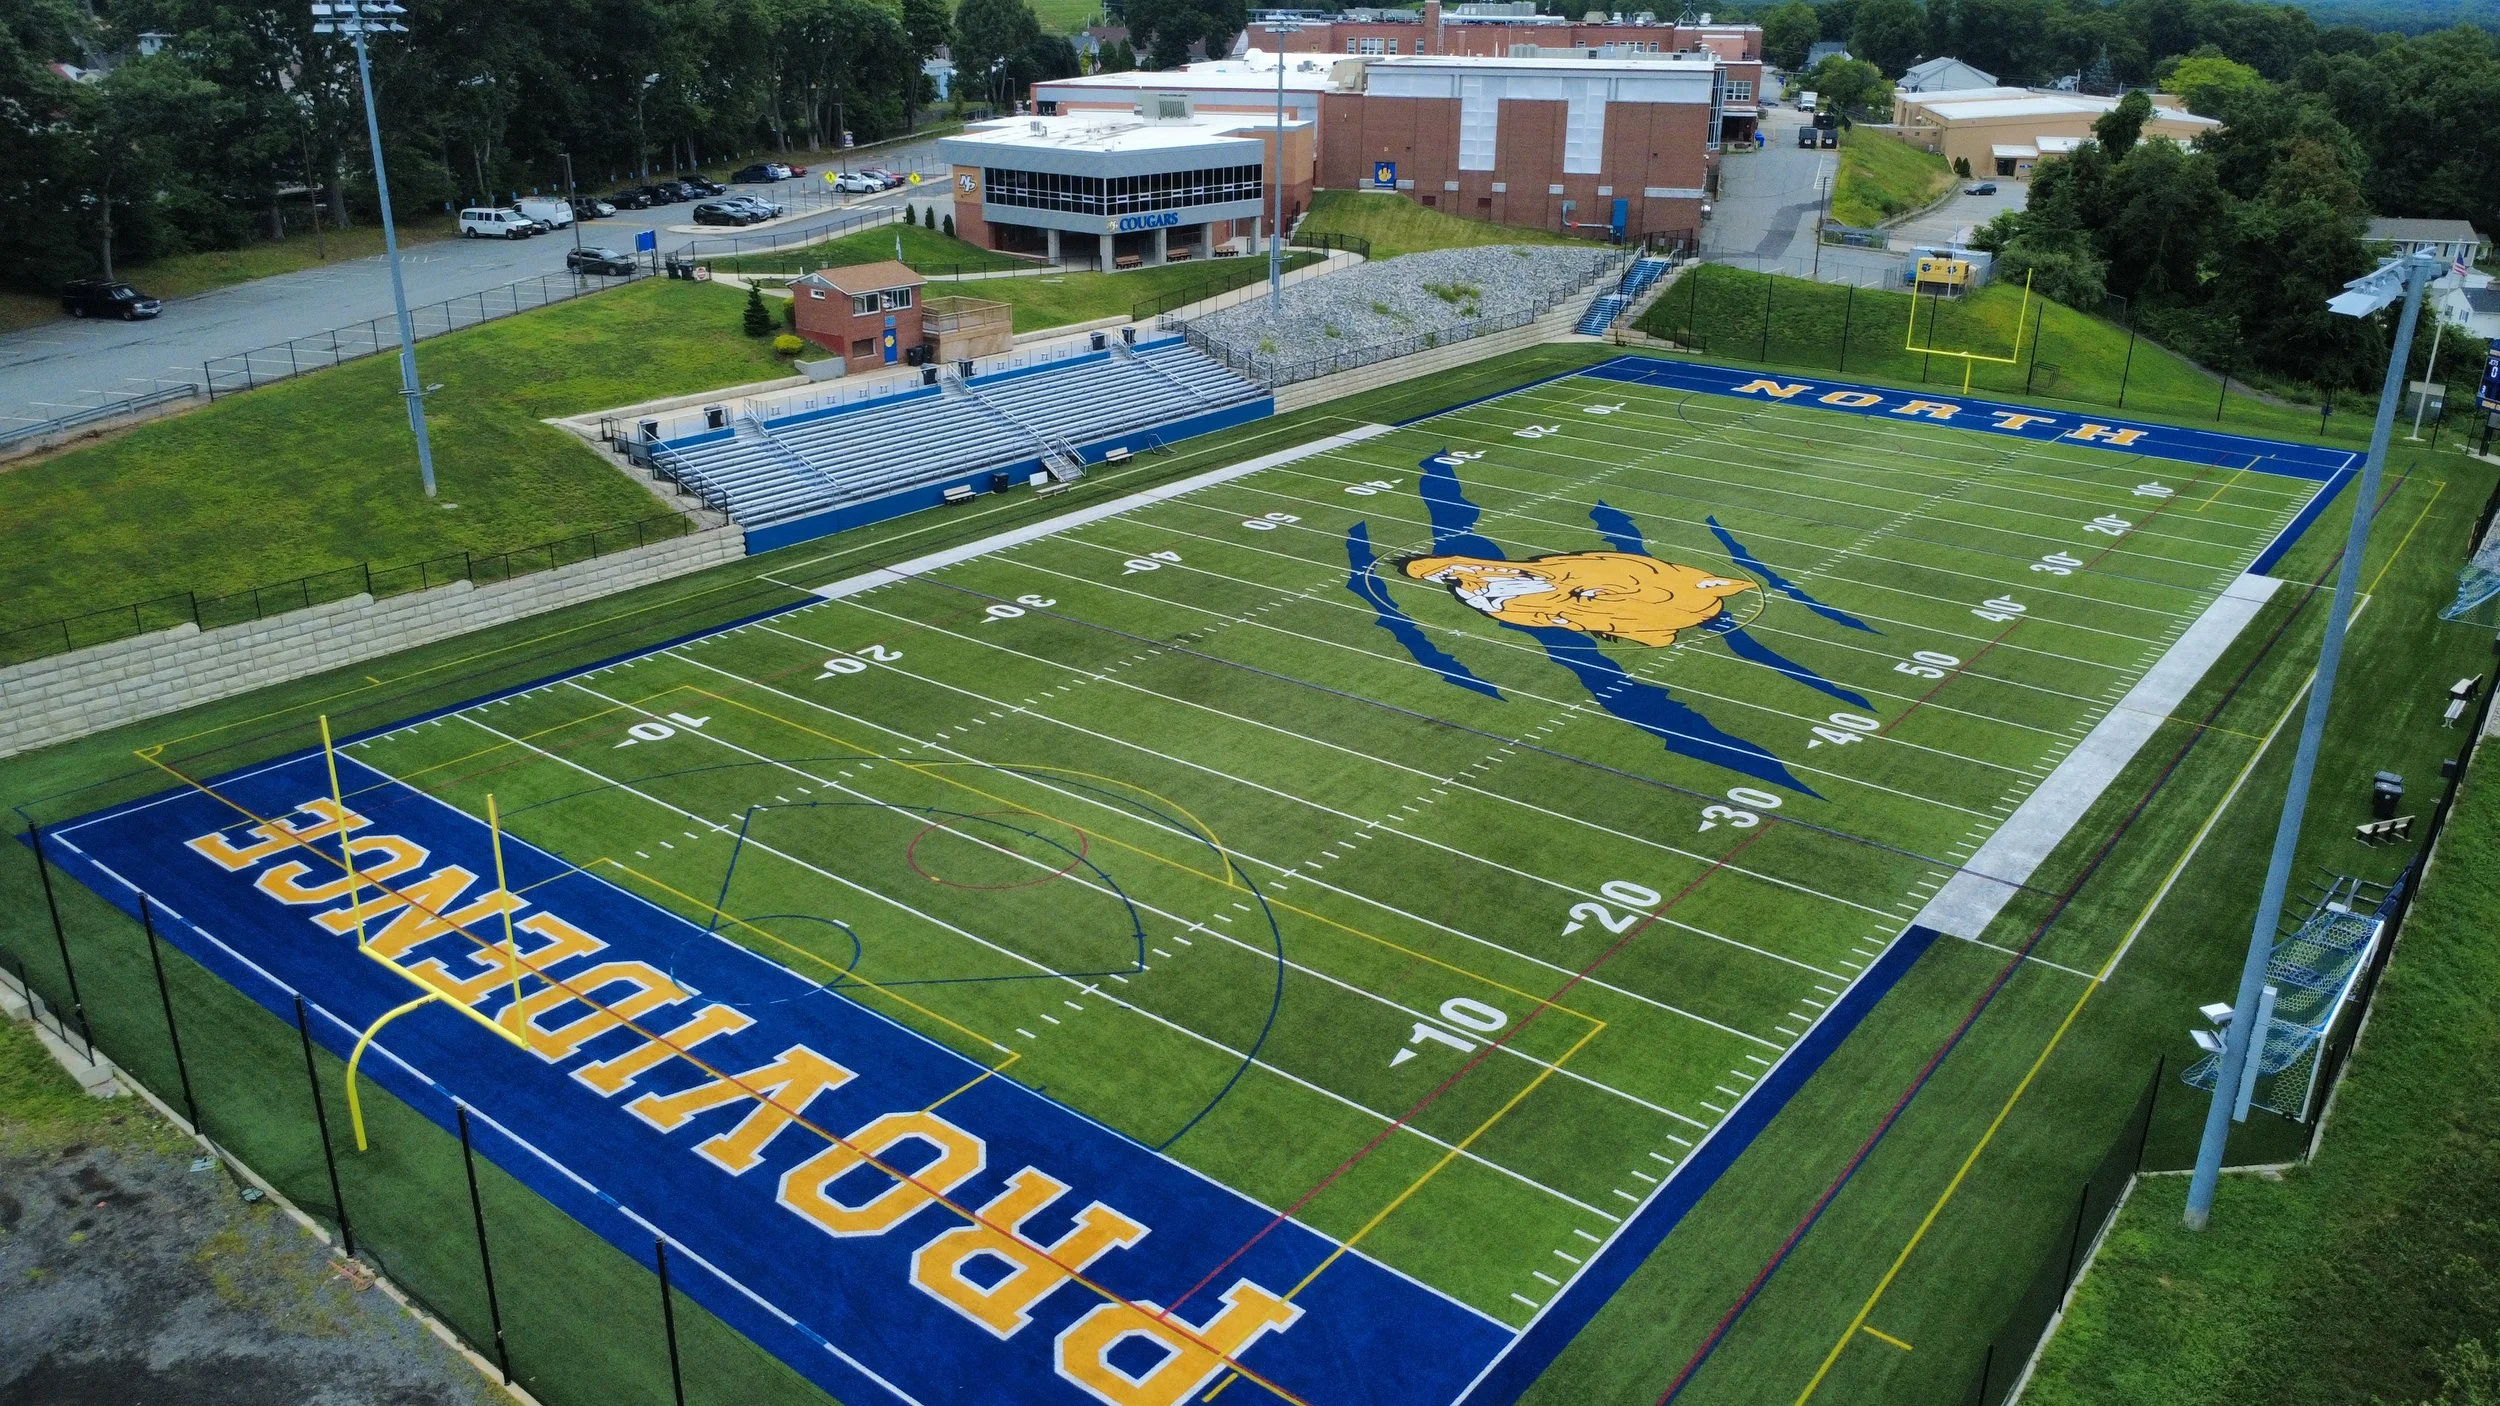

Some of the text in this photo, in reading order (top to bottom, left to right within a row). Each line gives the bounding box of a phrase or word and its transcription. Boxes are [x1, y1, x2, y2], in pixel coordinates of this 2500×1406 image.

[1120, 212, 1179, 231] COUGARS
[1583, 404, 1621, 415] 10
[1731, 380, 2149, 446] NORTH
[1513, 425, 1558, 438] 20
[1434, 451, 1482, 465] 30
[1344, 480, 1394, 496] 40
[2132, 483, 2174, 498] 10
[1242, 512, 1301, 531] 50
[2082, 516, 2132, 536] 20
[1123, 550, 1183, 571] 40
[2029, 554, 2083, 576] 30
[985, 594, 1057, 618] 30
[1970, 599, 2028, 622] 40
[823, 645, 904, 674] 20
[1893, 651, 1960, 679] 50
[628, 712, 711, 741] 10
[1811, 713, 1880, 745] 40
[1701, 787, 1783, 828] 30
[1569, 880, 1662, 934] 20
[1409, 997, 1508, 1053] 10
[184, 797, 1306, 1406] PROVIDENCE
